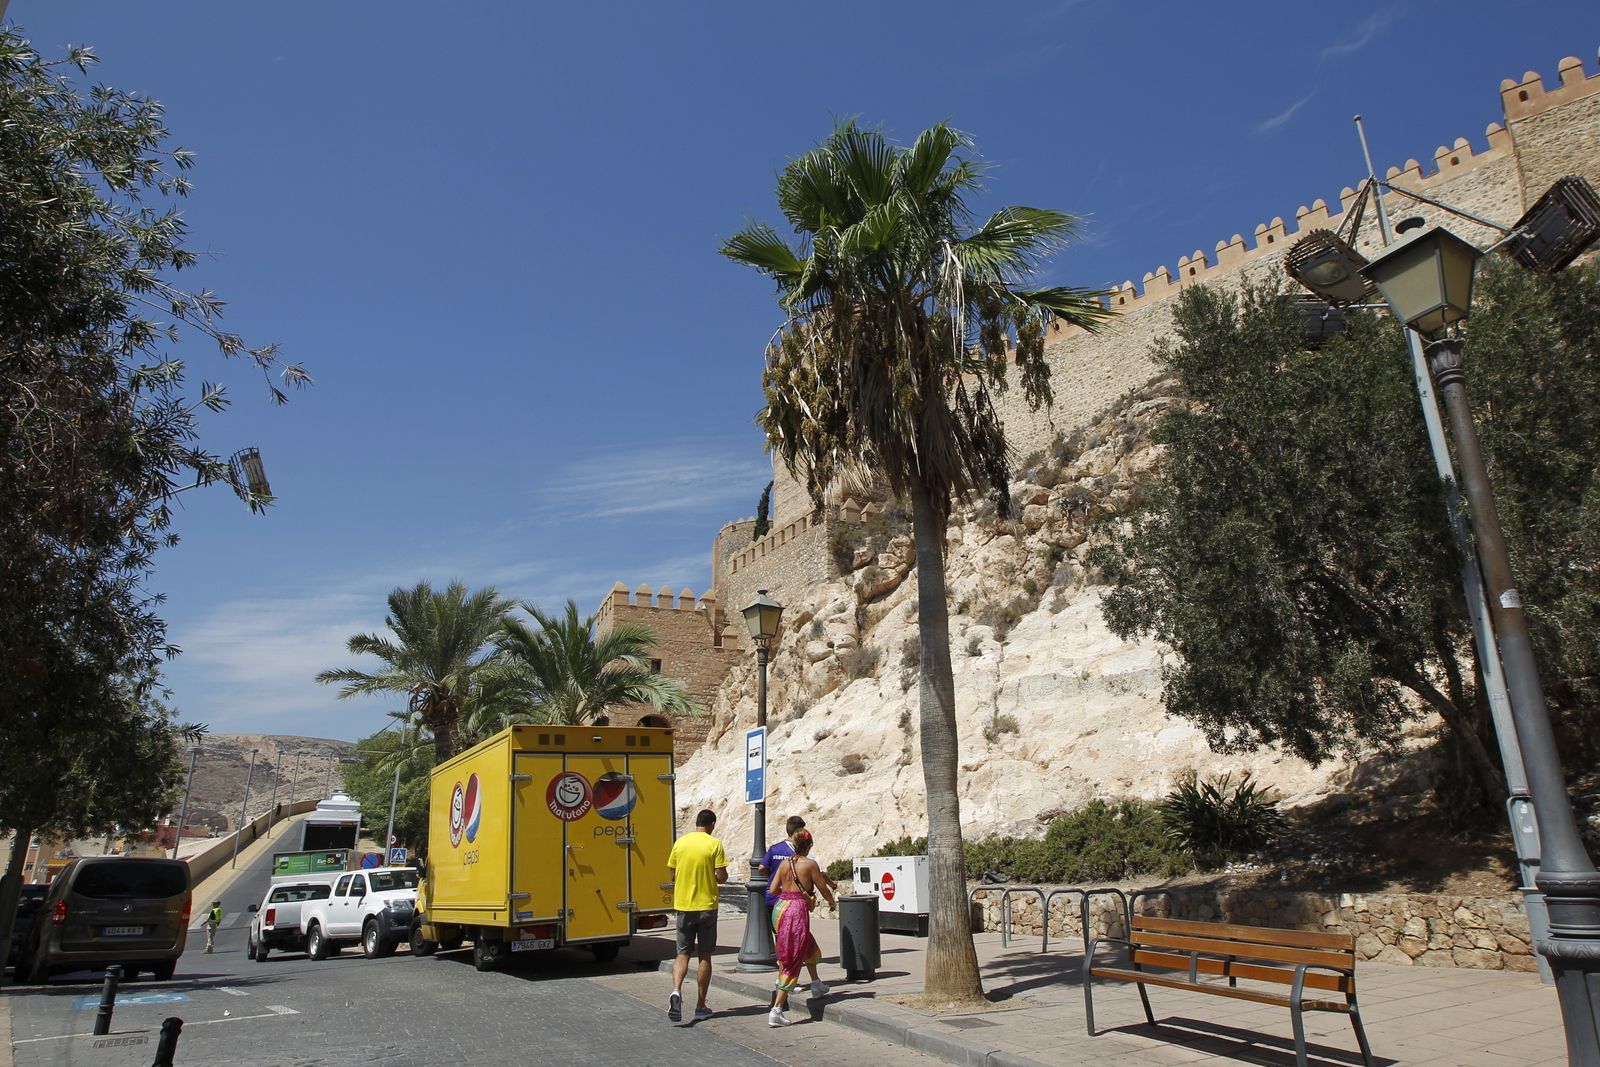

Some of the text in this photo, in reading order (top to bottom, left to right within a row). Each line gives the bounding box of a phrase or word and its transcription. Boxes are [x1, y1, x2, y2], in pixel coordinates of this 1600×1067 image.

[549, 800, 591, 819] matutano
[593, 824, 635, 839] pepsi
[463, 846, 480, 869] pepsi
